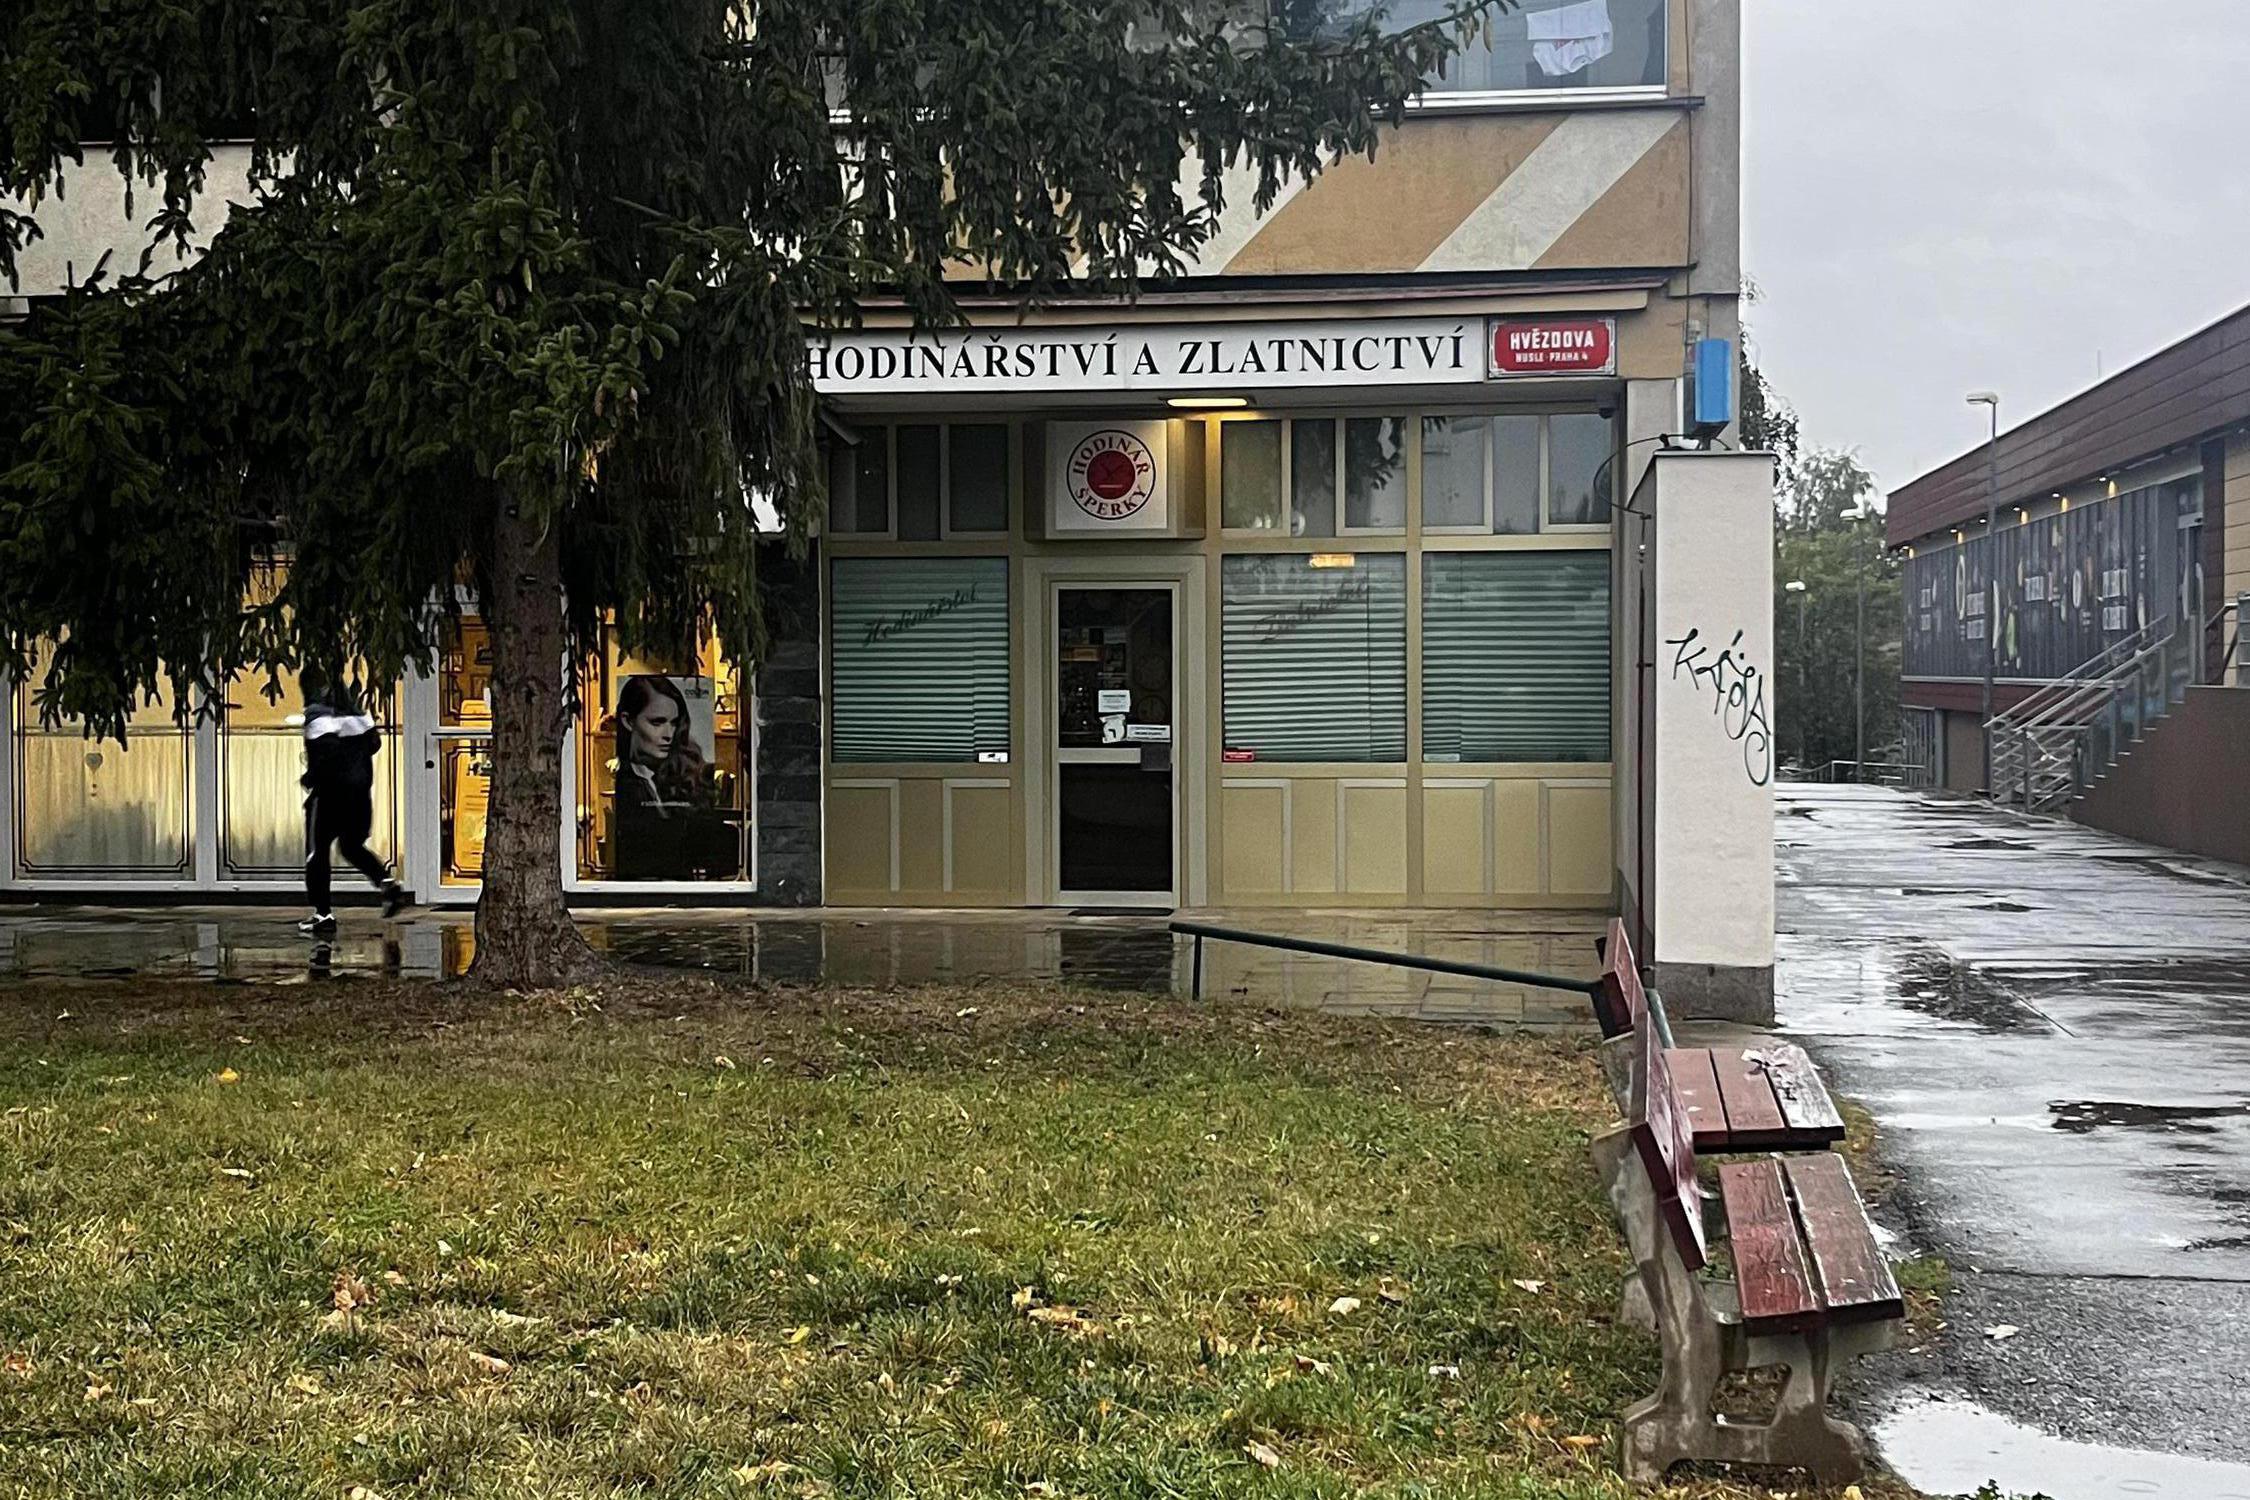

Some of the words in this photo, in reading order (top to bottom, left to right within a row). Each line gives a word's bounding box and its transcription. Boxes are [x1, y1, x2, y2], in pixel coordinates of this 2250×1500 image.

[1510, 328, 1595, 351] HVĚZDOVA
[806, 333, 1117, 380] HODINÁŘSTVÍ
[1131, 343, 1161, 376] A
[1179, 325, 1465, 375] ZLATNICTVÍ
[1515, 352, 1544, 363] NUSLE
[1549, 351, 1579, 362] PRAHA
